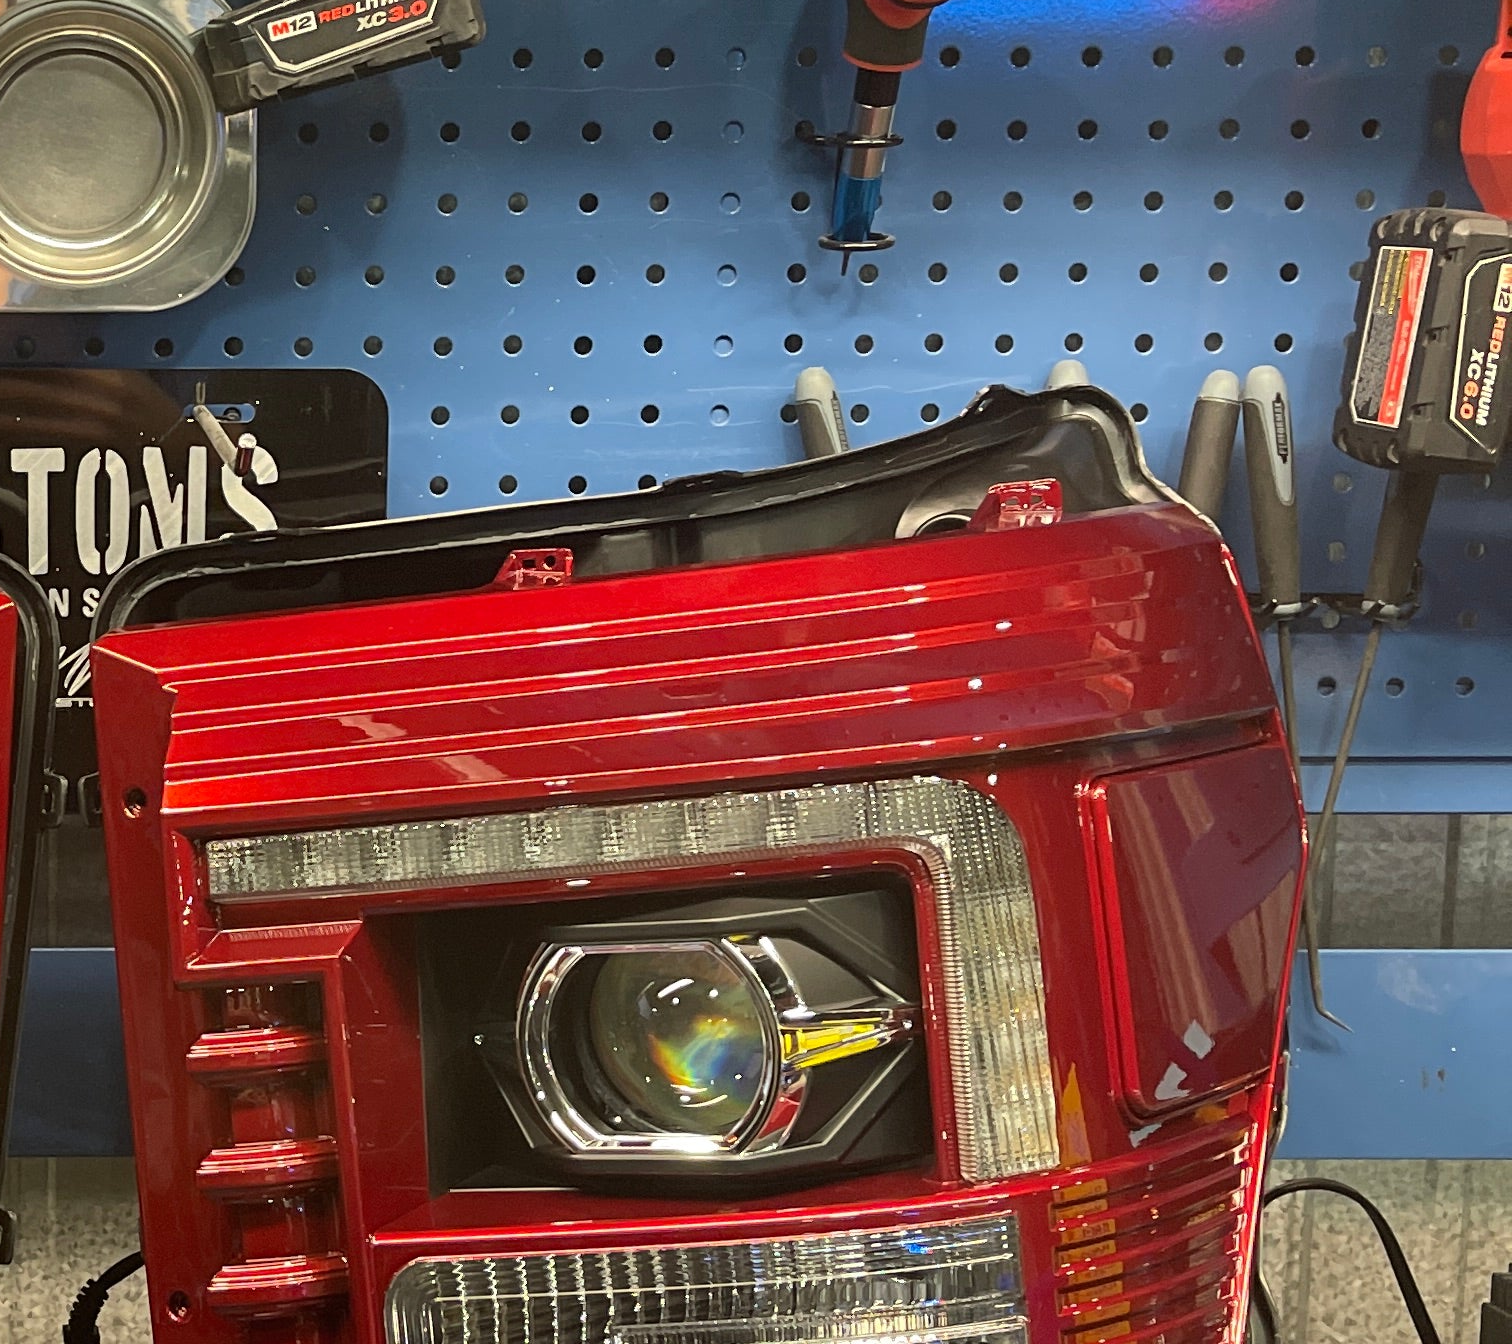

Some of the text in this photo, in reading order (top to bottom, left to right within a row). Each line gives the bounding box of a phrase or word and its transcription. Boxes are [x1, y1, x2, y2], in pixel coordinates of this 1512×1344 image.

[271, 14, 313, 37] M12
[356, 0, 428, 32] XC3.0
[1459, 347, 1485, 421] XC6.0
[1475, 315, 1507, 427] REDLITHIUM
